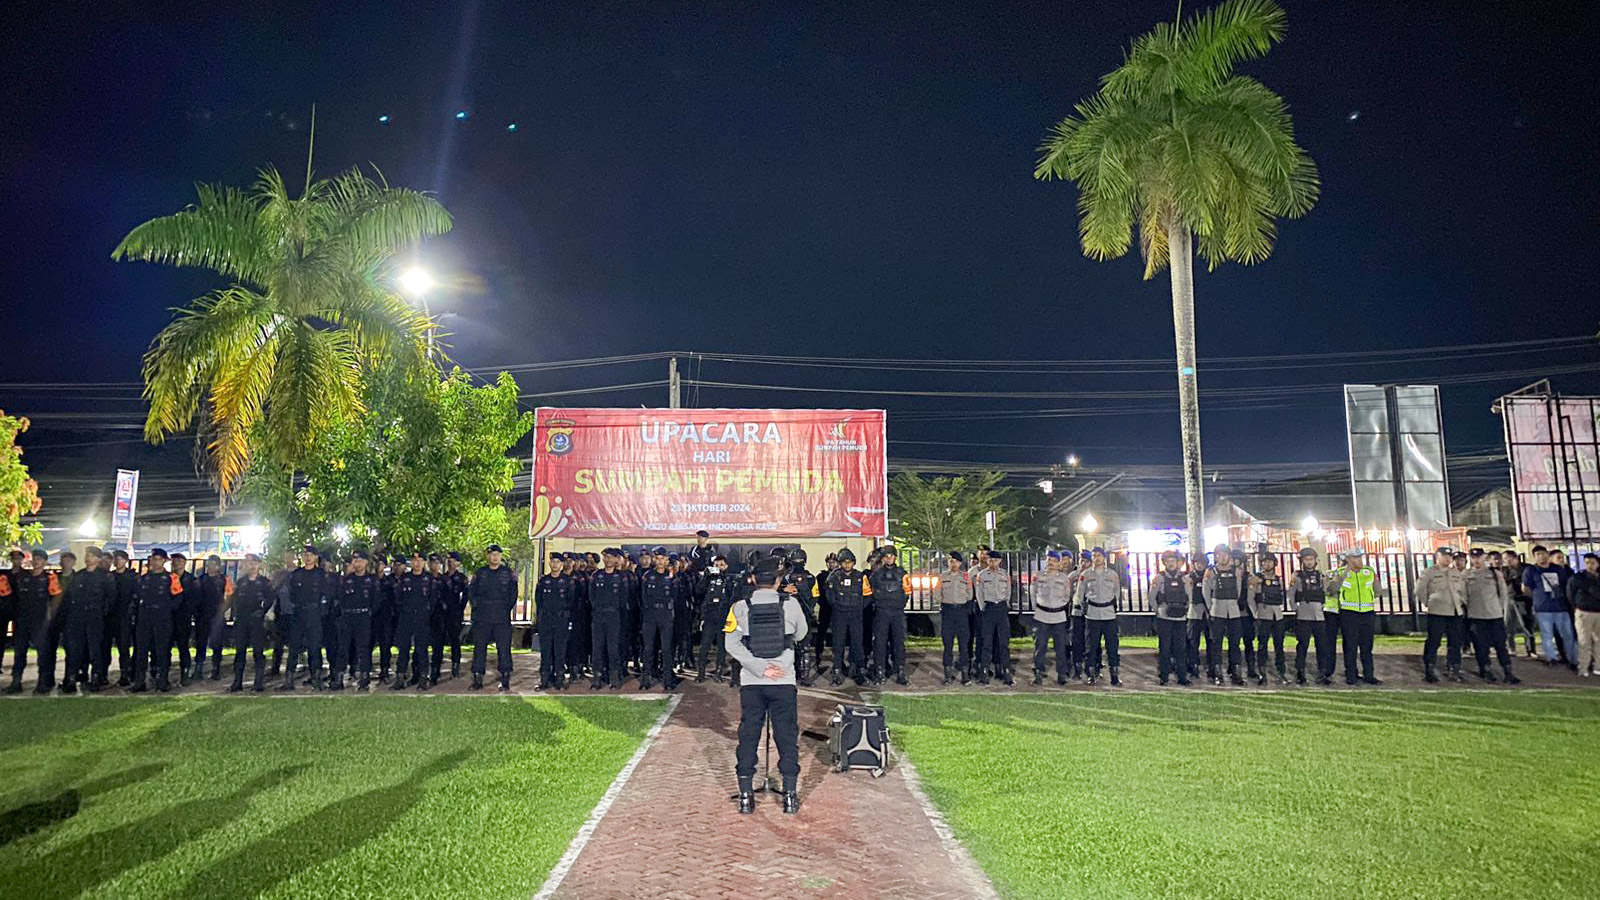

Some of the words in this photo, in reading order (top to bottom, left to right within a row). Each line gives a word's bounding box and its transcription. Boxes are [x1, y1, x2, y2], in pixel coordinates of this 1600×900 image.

[641, 420, 782, 444] UPACARA
[692, 450, 731, 463] HARI
[574, 467, 706, 494] SUMPAH
[716, 467, 845, 494] PEMUDA
[685, 503, 727, 512] OKTOBER
[729, 503, 751, 512] 2024
[709, 522, 754, 531] INDONESIA
